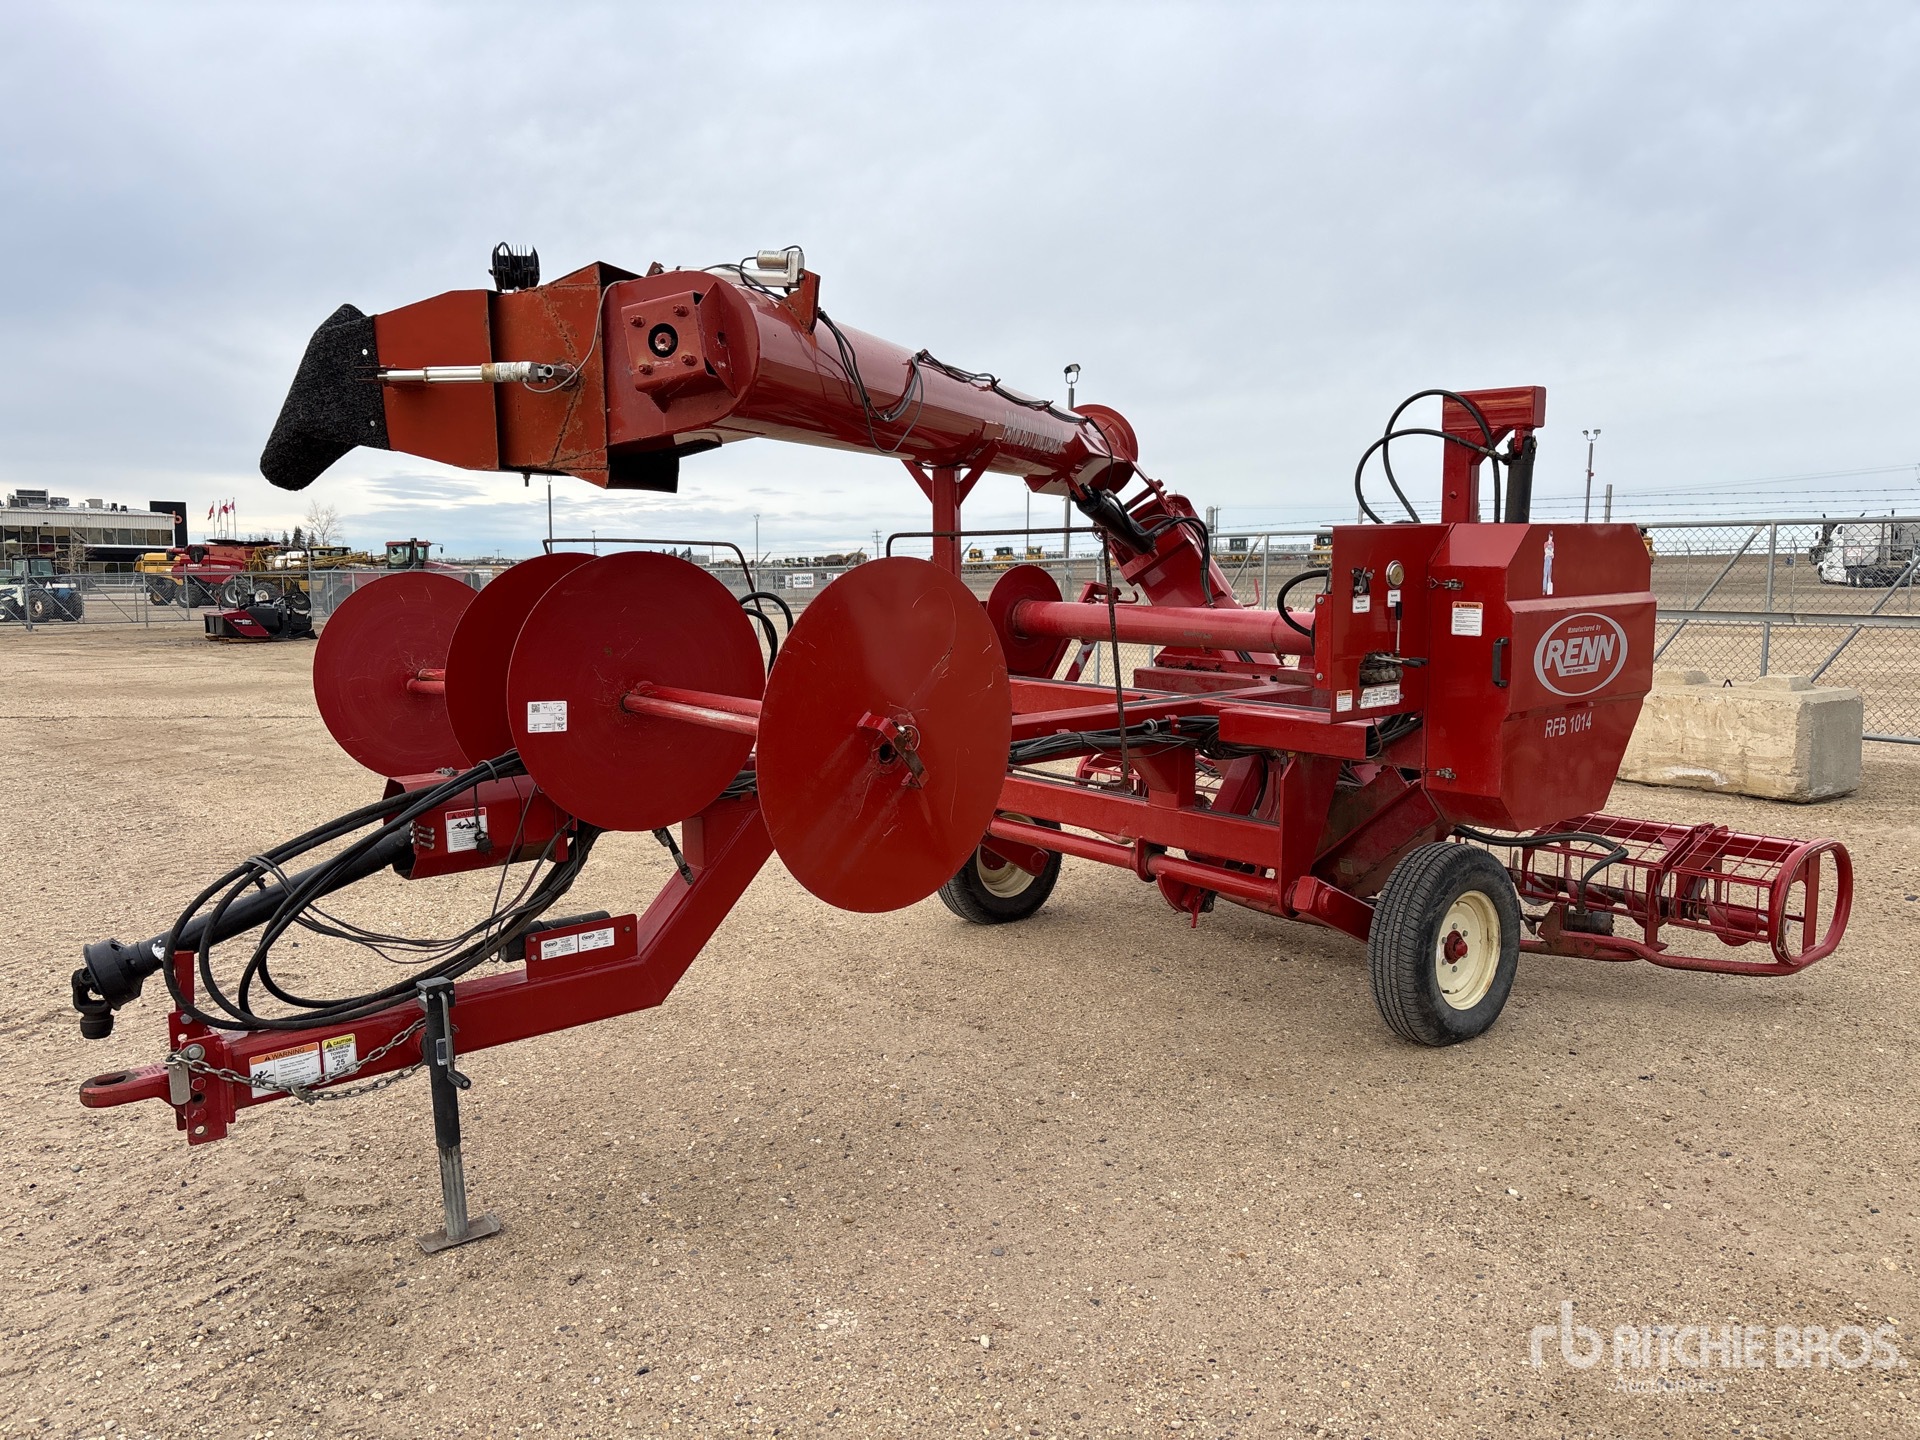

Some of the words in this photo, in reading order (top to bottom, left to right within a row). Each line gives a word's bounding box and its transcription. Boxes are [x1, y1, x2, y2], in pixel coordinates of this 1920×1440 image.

[172, 510, 183, 524] b
[1544, 634, 1616, 672] RENN
[1544, 716, 1567, 739] RFB
[1569, 711, 1592, 734] 1014
[457, 810, 482, 818] DANGR
[333, 1037, 353, 1045] CAUTION
[271, 1047, 305, 1060] WARNING
[327, 1044, 350, 1052] MAXIMUM
